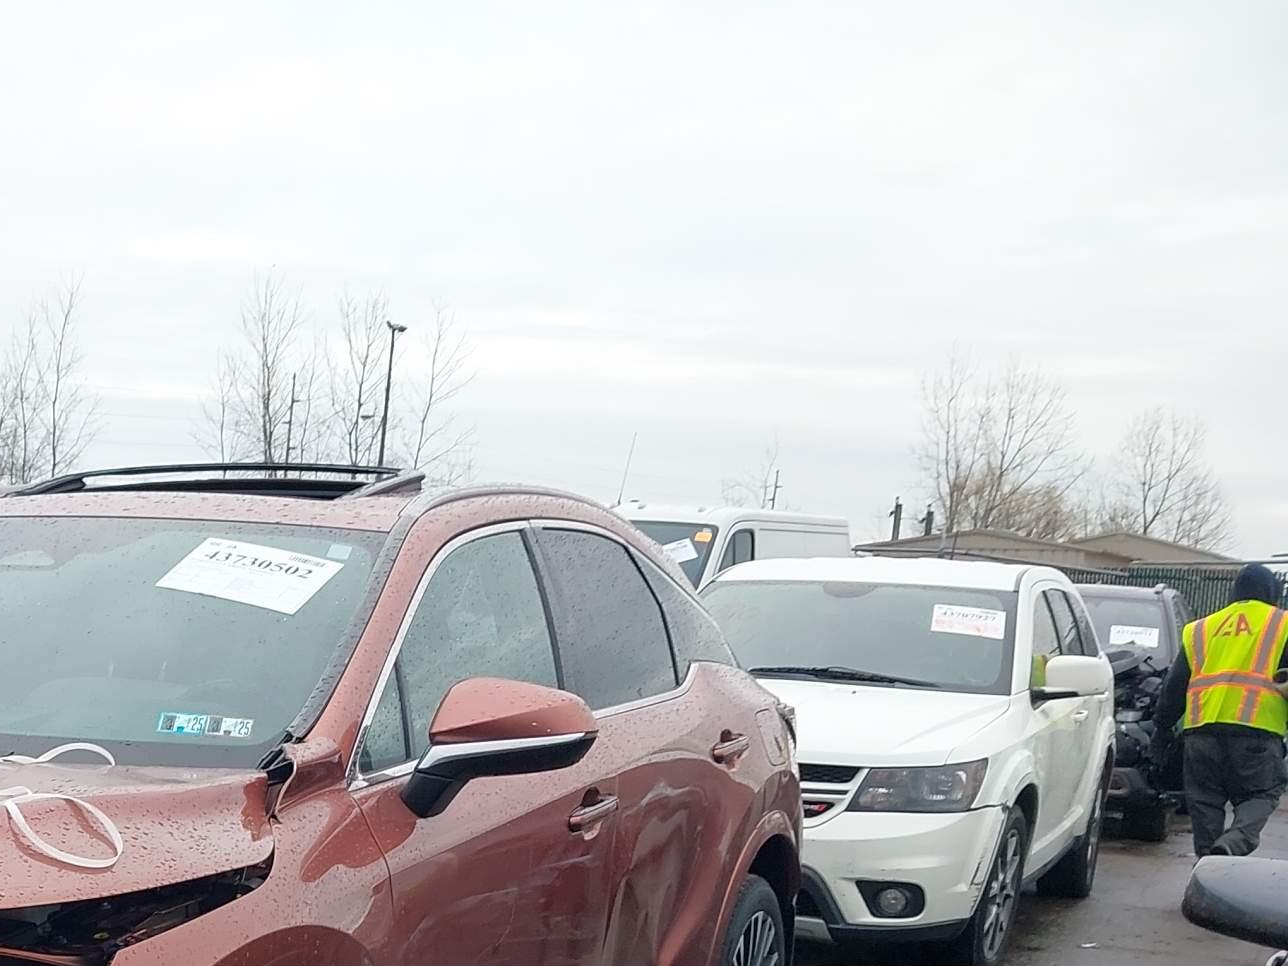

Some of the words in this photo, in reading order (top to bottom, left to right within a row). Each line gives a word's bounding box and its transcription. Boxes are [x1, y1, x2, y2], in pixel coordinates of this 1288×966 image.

[204, 550, 313, 579] 43730502
[191, 717, 205, 731] 25
[238, 720, 250, 736] 25
